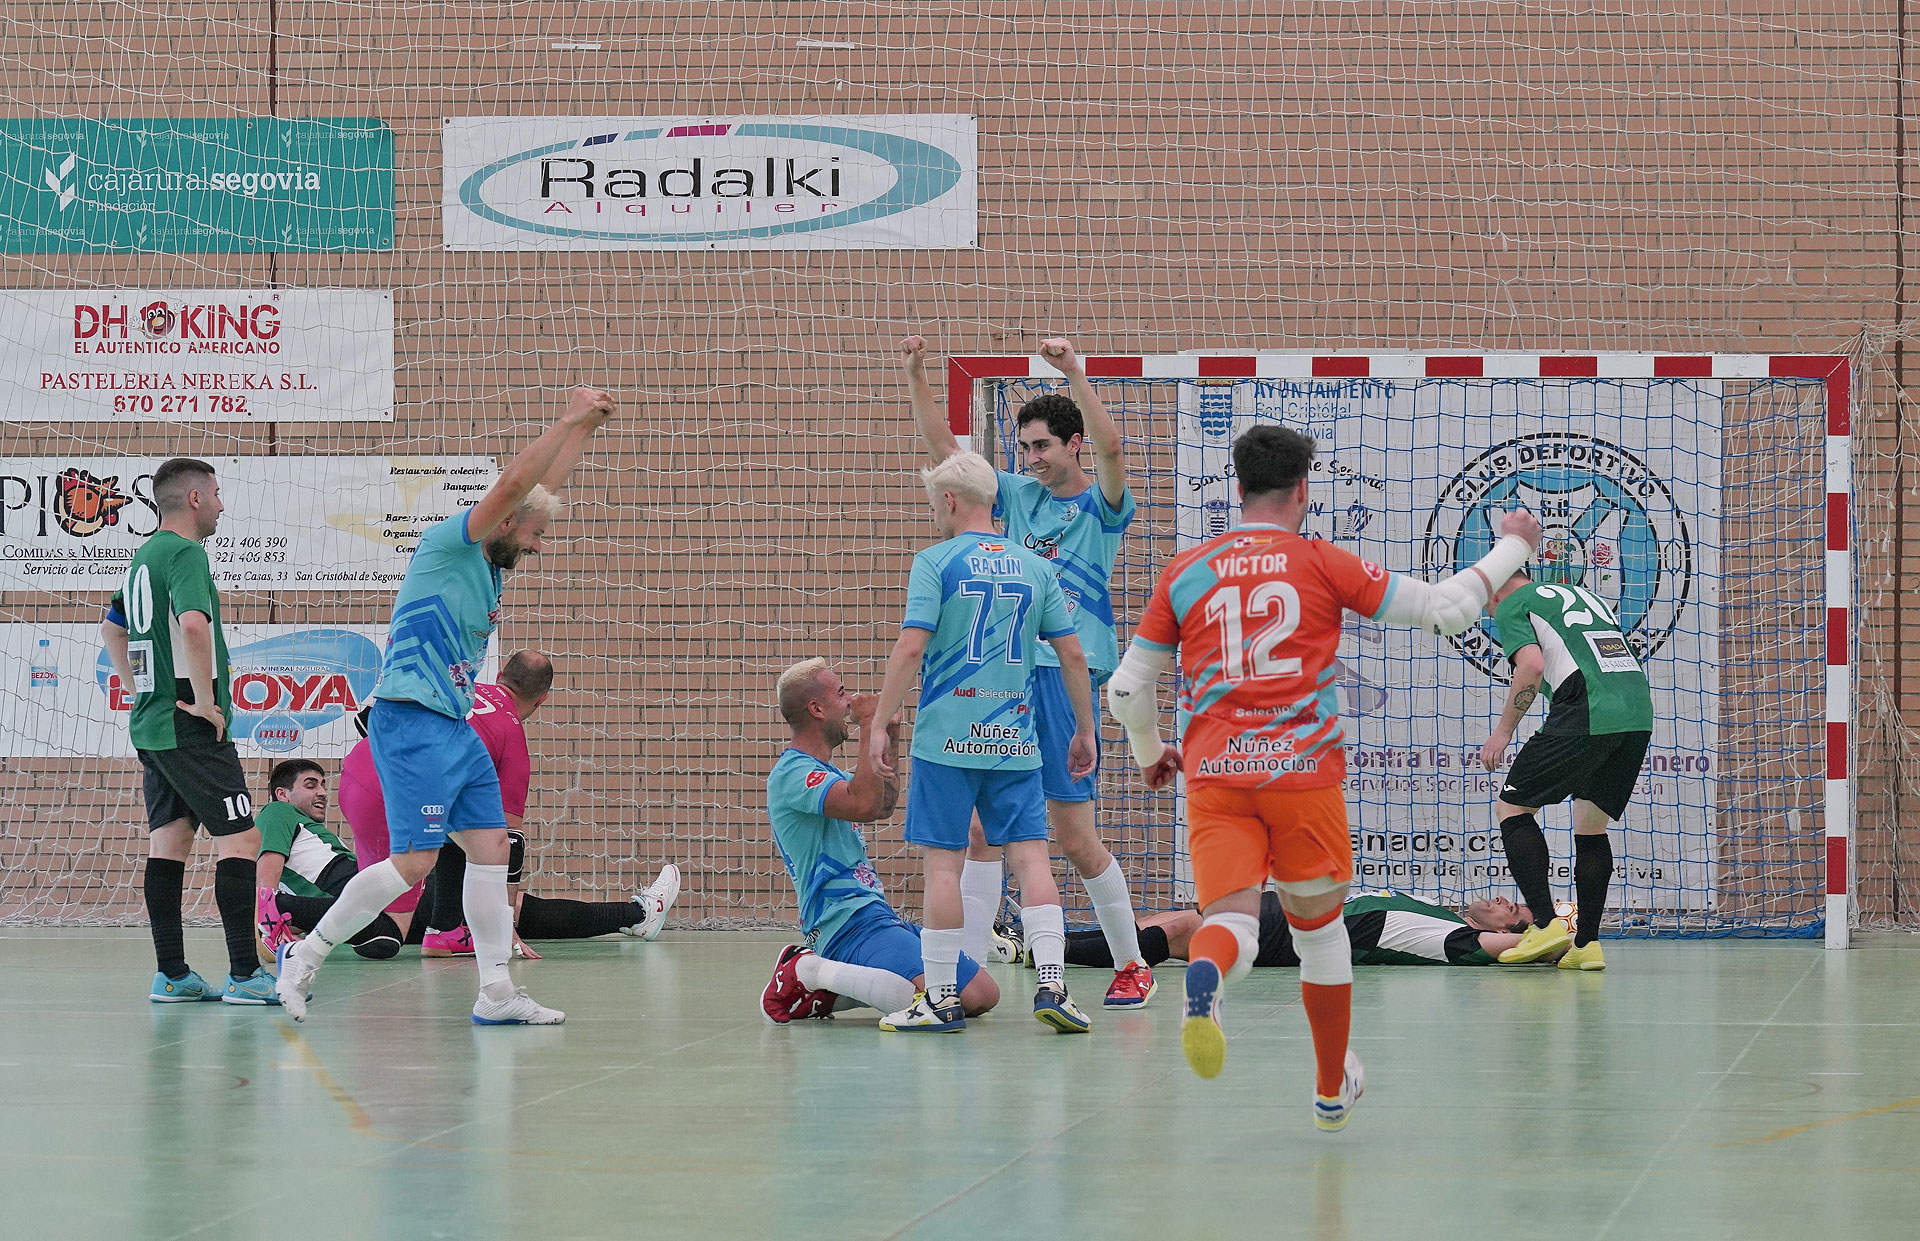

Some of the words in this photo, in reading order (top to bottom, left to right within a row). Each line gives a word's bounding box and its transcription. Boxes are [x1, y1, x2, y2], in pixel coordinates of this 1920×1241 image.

[88, 167, 320, 196] cajaruralsegovia
[540, 157, 841, 198] Radalki
[543, 200, 838, 216] Alquiler
[75, 342, 90, 354] EL
[99, 342, 181, 354] AUTENTICO
[188, 341, 281, 354] AMERICANO
[40, 373, 176, 390] PASTELERIA
[182, 373, 273, 390] NEREKA
[280, 373, 318, 390] S.L.
[114, 395, 154, 414] 670
[160, 395, 199, 414] 271
[209, 395, 247, 414] 782
[215, 537, 236, 548] 921
[240, 537, 262, 548] 406
[264, 537, 288, 548] 390
[214, 552, 235, 563] 921
[238, 552, 261, 563] 406
[263, 552, 286, 563] 853
[1215, 553, 1288, 579] VÍCTOR
[23, 563, 68, 575] Servicio
[222, 571, 242, 581] Tres
[276, 571, 288, 581] 33
[295, 571, 312, 581] San
[314, 571, 357, 581] Cristóbal
[359, 571, 370, 581] de
[1535, 584, 1620, 628] 20
[958, 580, 1035, 666] 77
[1204, 581, 1303, 684] 12
[953, 687, 976, 698] Audi
[978, 688, 1025, 699] Selection
[1235, 704, 1300, 718] Selection
[259, 729, 299, 742] muy
[969, 722, 1019, 739] Núñez
[943, 737, 1037, 757] Automoción
[1227, 736, 1294, 754] Núñez
[223, 793, 251, 821] 10
